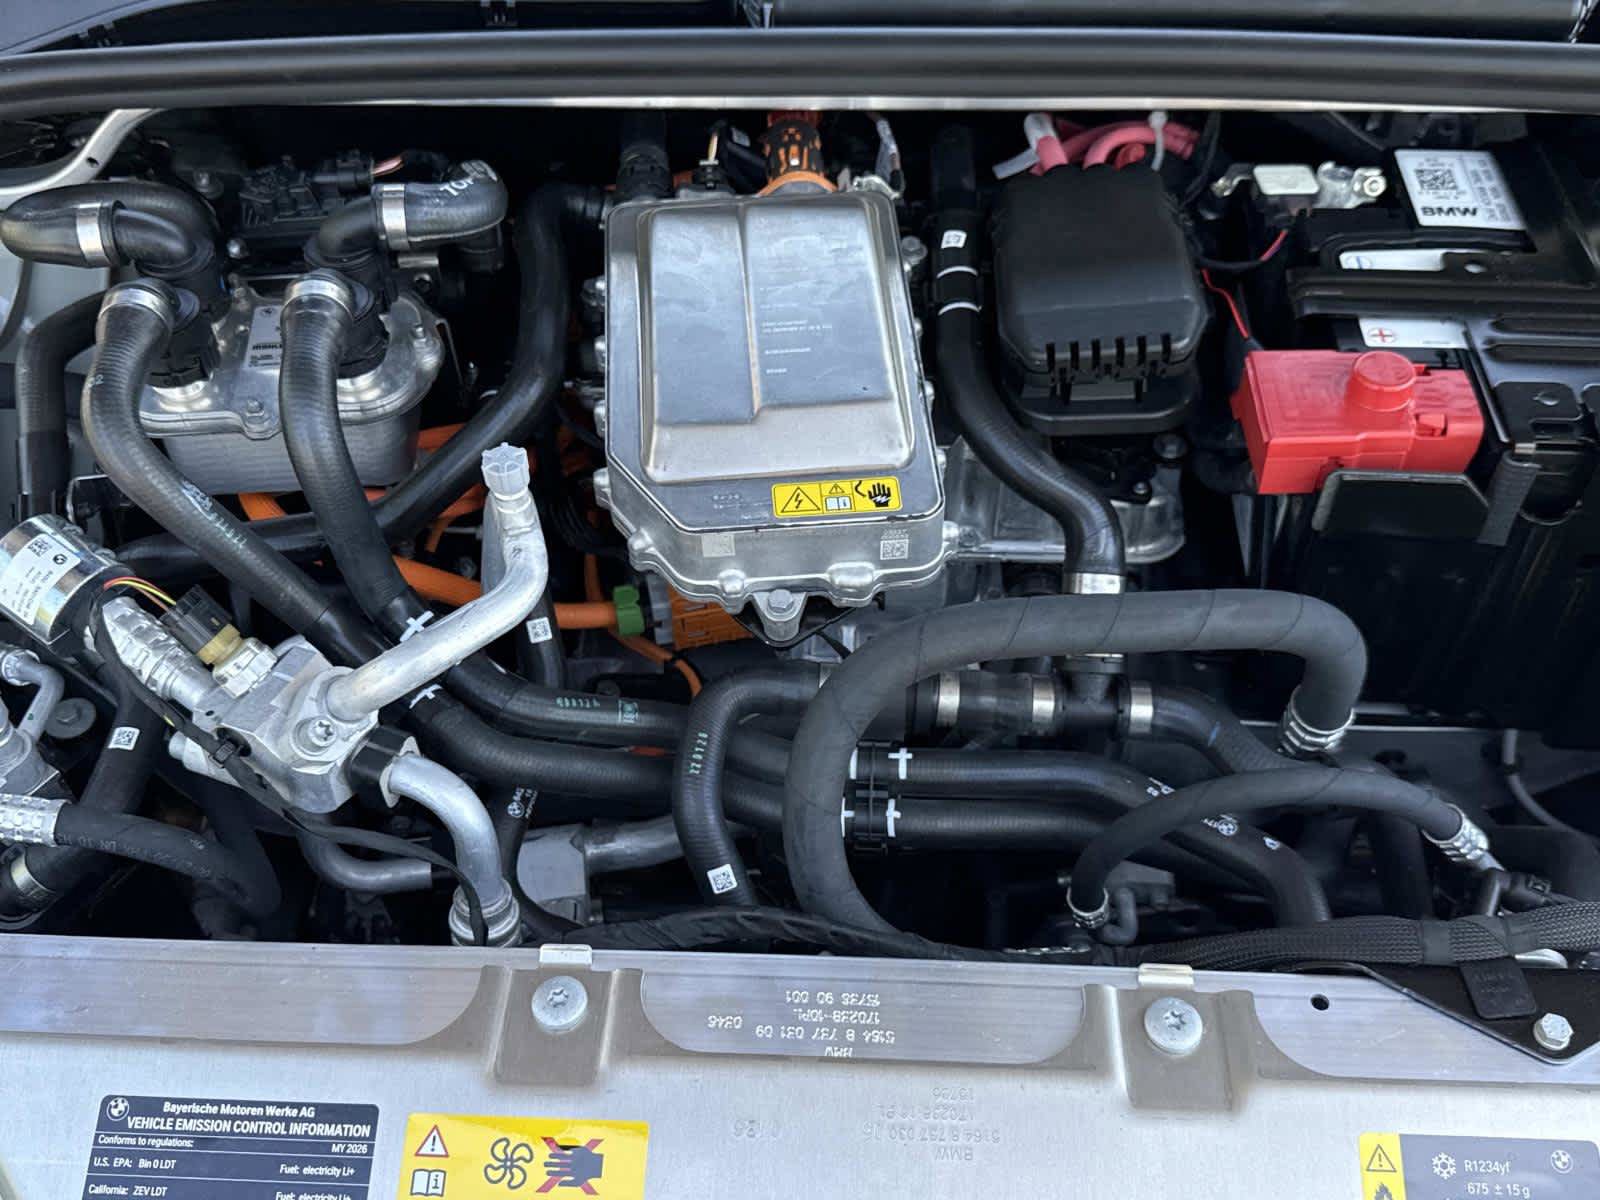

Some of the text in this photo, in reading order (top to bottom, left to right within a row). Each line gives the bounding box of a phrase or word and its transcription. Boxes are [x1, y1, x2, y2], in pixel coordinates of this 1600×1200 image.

[1421, 206, 1478, 217] BMW
[816, 991, 834, 1004] 90
[163, 1101, 316, 1118] Bayerische Motoren Werke AG
[127, 1116, 371, 1137] VEHICLE EMISSION CONTROL INFORMATION
[98, 1134, 194, 1148] Conforms to regulations:
[331, 1143, 368, 1154] MY 2026
[934, 1146, 974, 1161] BMW
[93, 1157, 177, 1169] U.S. EPA: Bin 0 LDT
[1463, 1159, 1511, 1176] R1234yf
[279, 1164, 355, 1178] Fuel: electricity Li+
[88, 1184, 168, 1197] California: ZEV LDT
[1467, 1183, 1489, 1195] 675
[1494, 1184, 1504, 1195] ±
